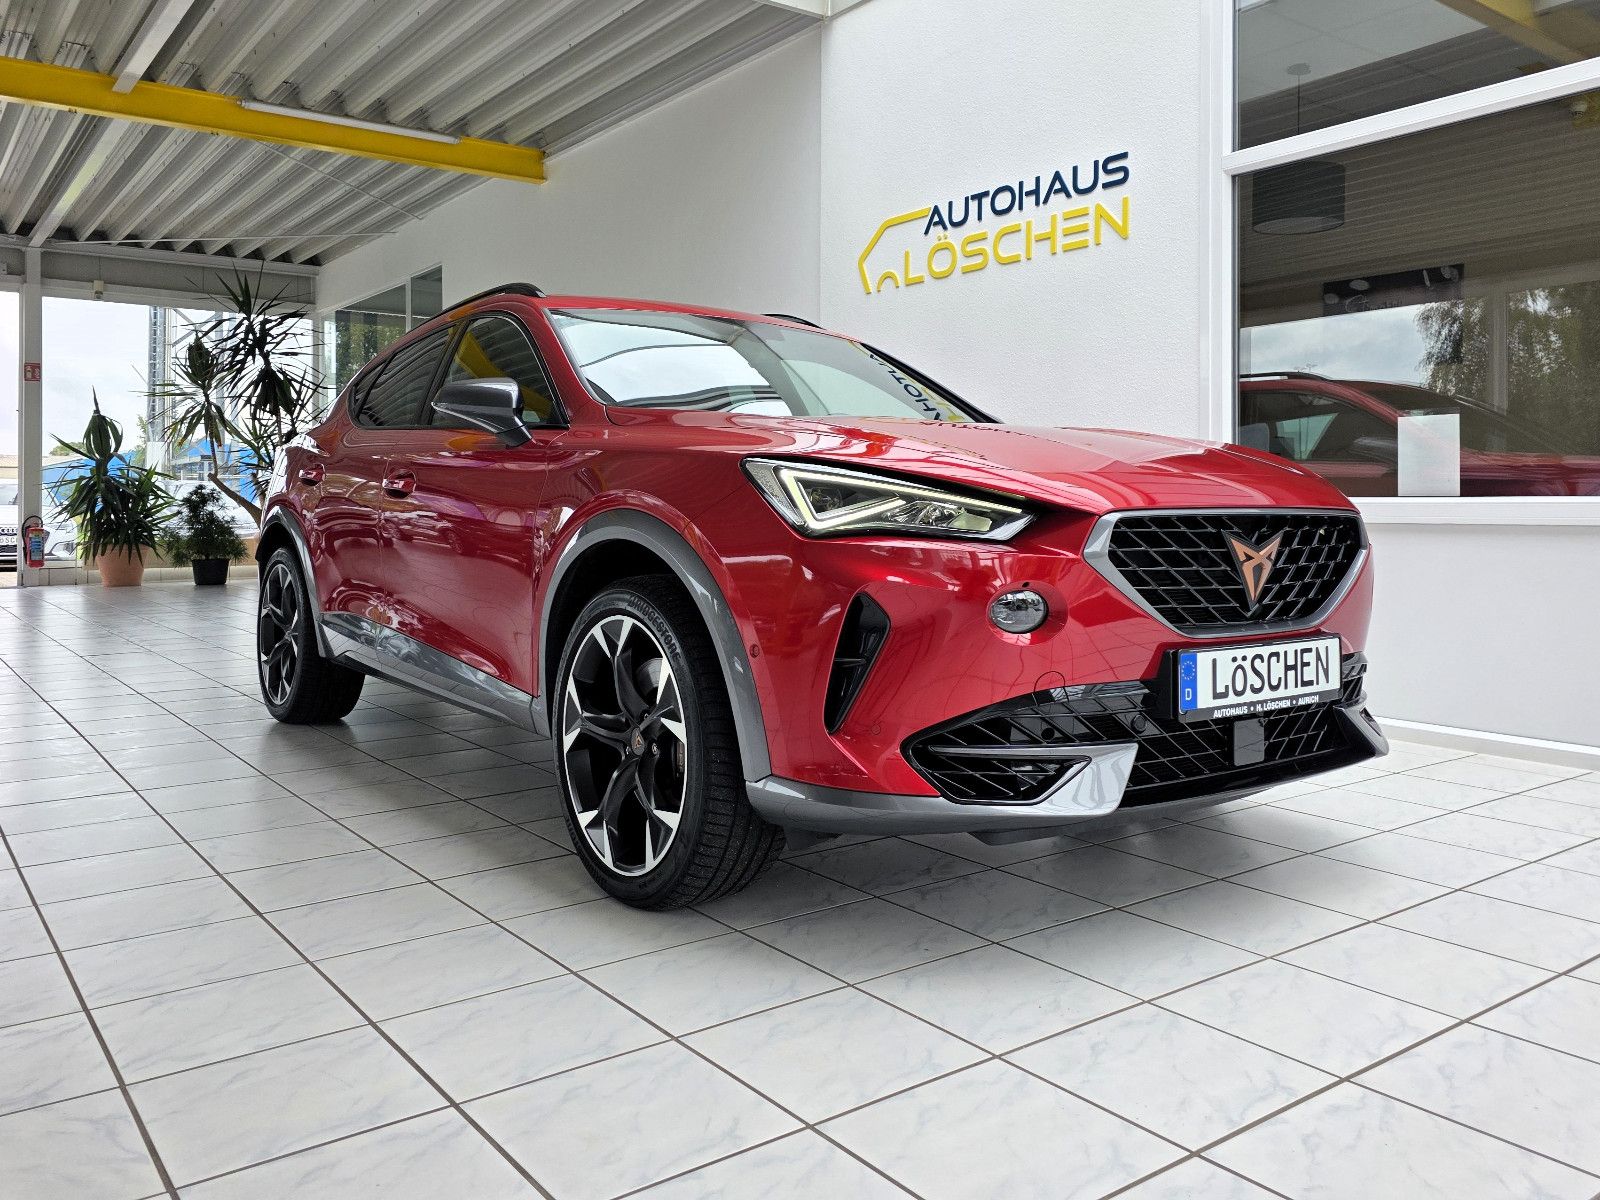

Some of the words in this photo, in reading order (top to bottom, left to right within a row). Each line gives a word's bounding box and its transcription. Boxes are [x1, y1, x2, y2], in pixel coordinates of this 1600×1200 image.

[924, 151, 1130, 236] AUTOHAUS
[904, 195, 1130, 286] LÖSCHEN
[1185, 688, 1192, 701] D
[1212, 645, 1330, 700] LÖSCHEN
[1213, 705, 1248, 718] AUTOHAUS
[1256, 703, 1263, 712] H.
[1264, 698, 1291, 711] LÖSCHEN
[1298, 695, 1319, 706] AURICH
